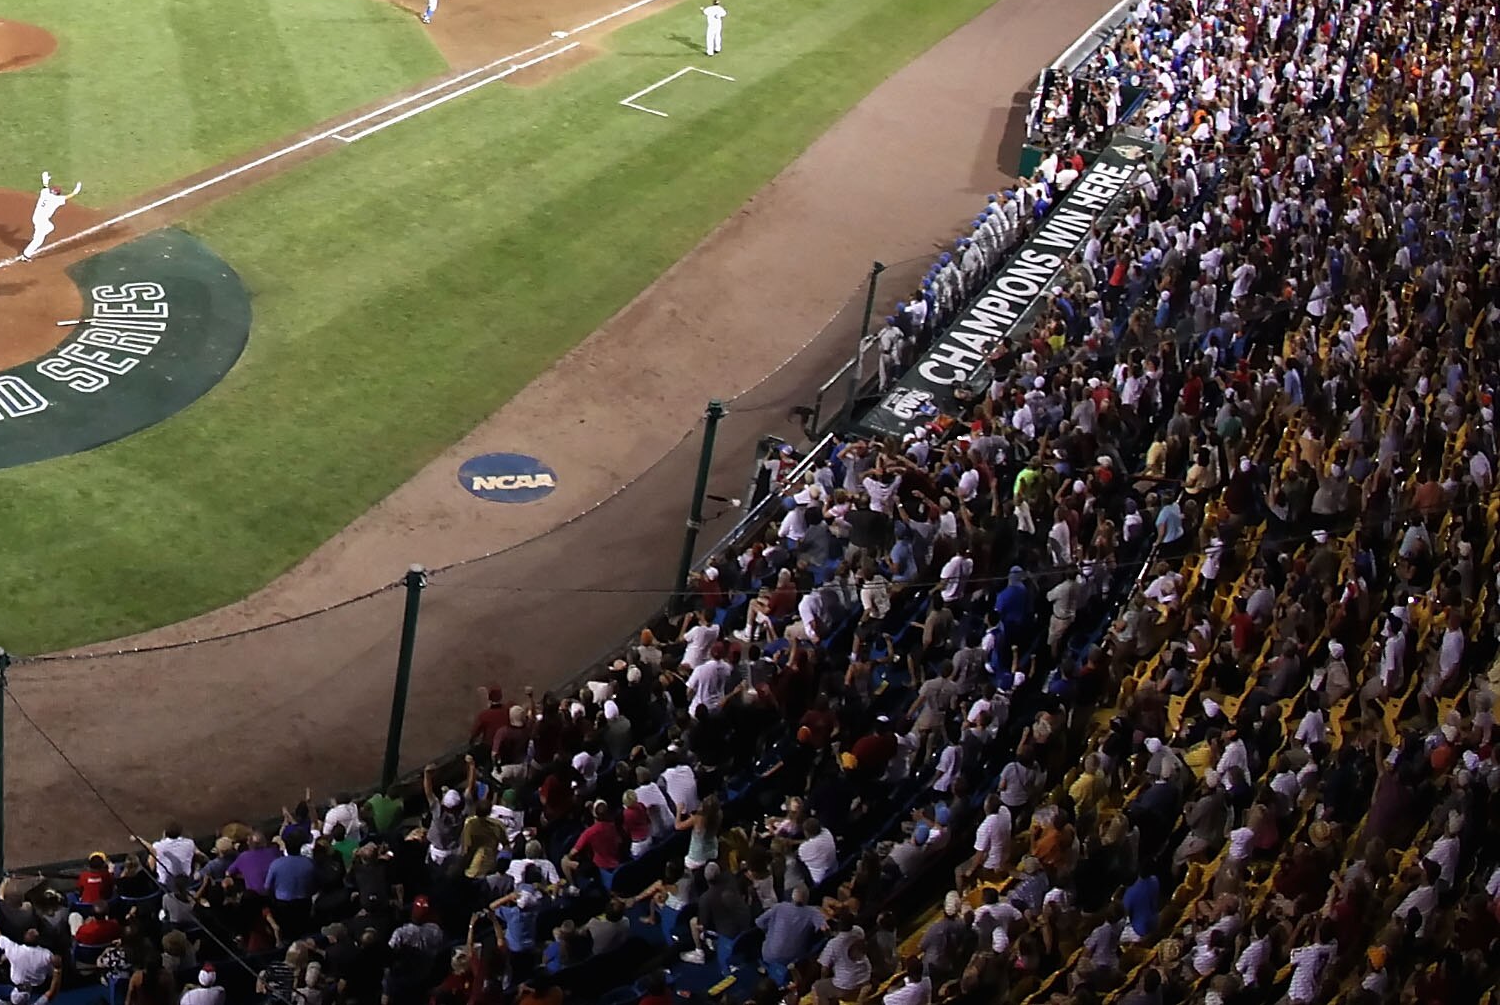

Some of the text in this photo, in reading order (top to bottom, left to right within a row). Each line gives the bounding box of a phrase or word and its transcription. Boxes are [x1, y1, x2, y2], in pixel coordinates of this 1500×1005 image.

[918, 162, 1136, 386] CHAMPIONS WIN HERE.
[36, 281, 170, 393] SERIES
[472, 473, 556, 491] NCAA
